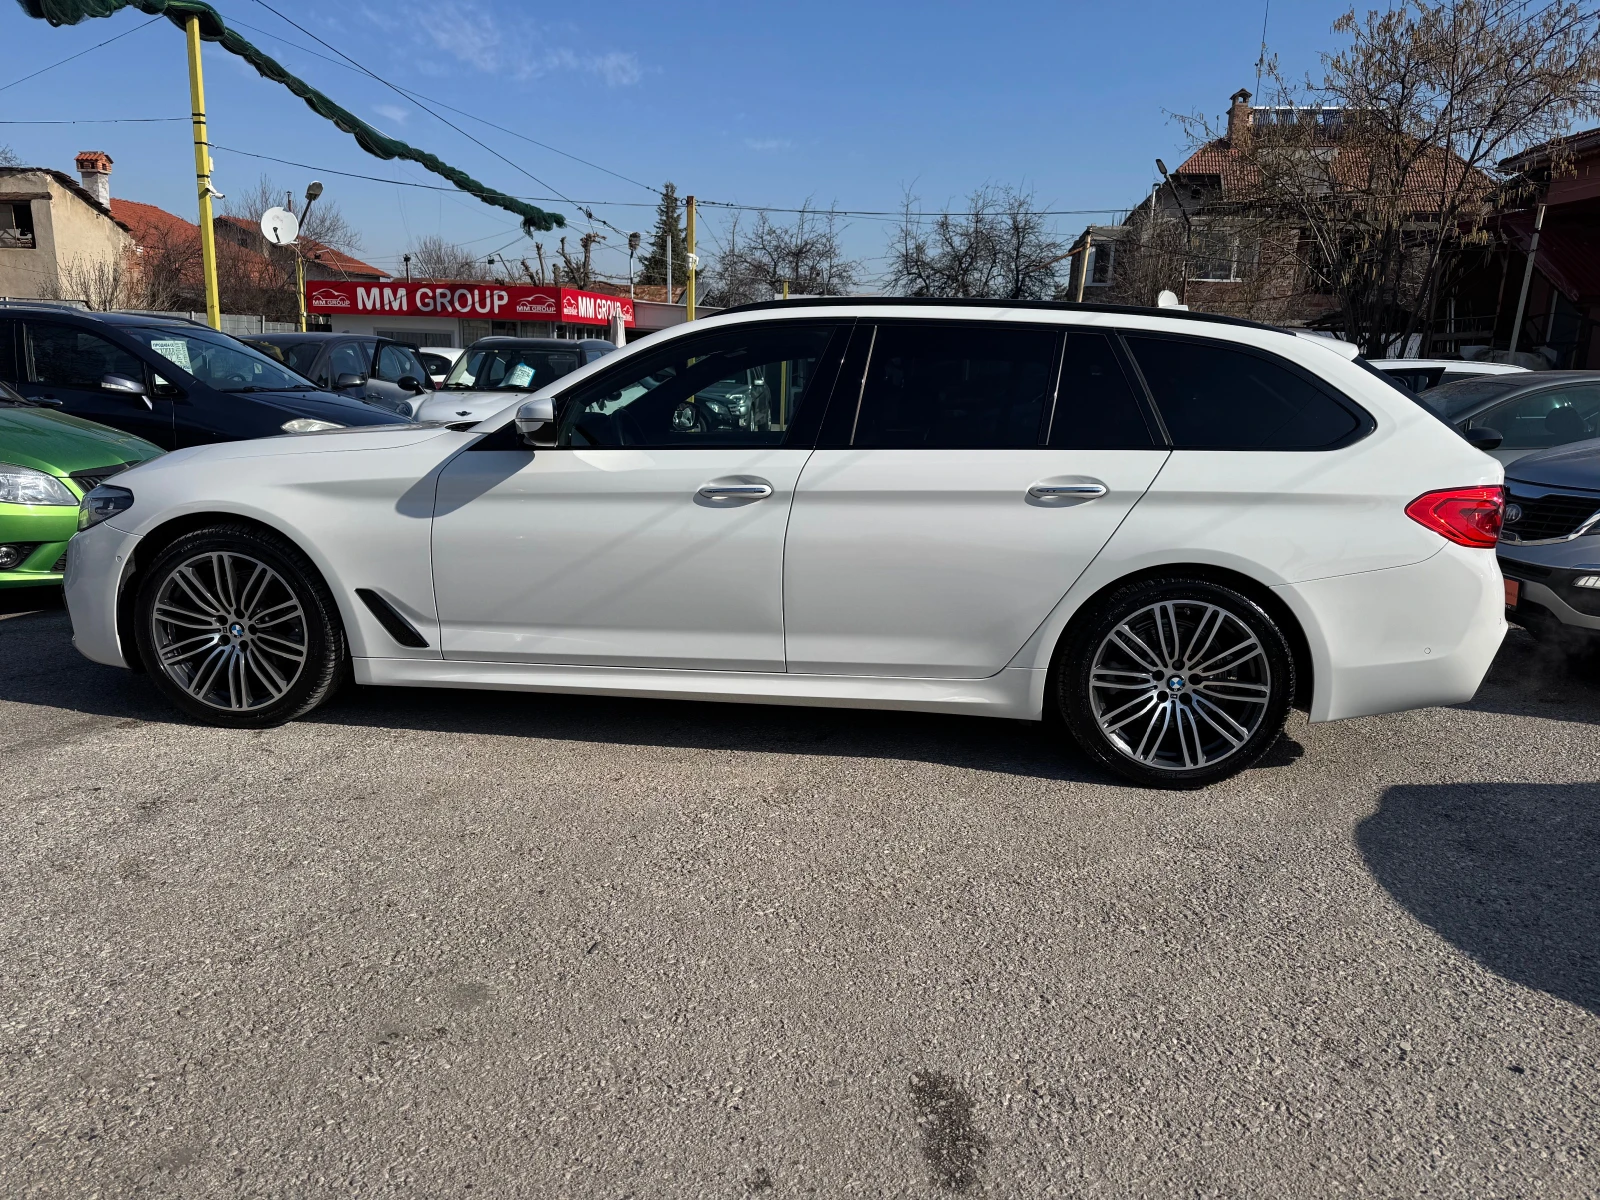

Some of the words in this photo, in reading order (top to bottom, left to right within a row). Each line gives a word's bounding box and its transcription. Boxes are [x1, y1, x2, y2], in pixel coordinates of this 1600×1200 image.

[356, 286, 408, 311] MM
[415, 287, 508, 313] GROUP
[578, 296, 595, 318] MM
